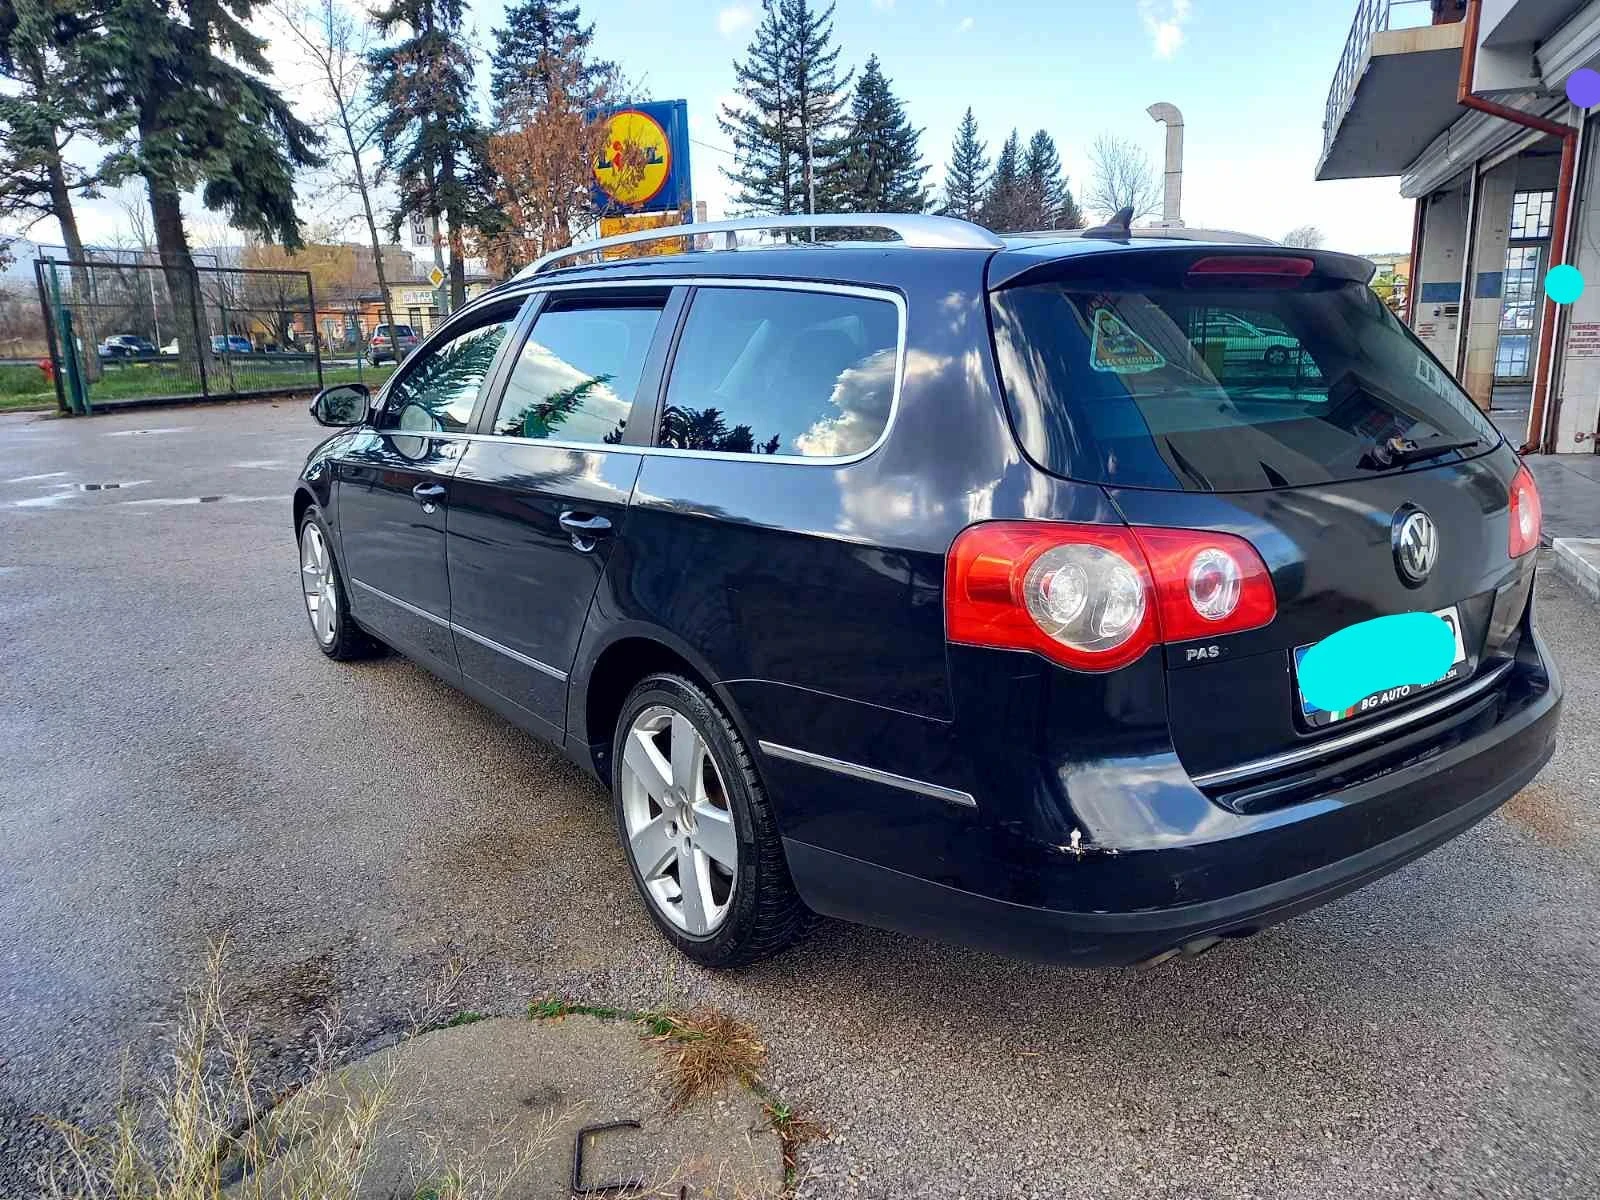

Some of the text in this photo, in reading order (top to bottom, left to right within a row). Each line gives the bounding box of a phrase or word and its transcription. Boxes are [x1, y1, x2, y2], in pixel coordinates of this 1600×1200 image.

[1186, 645, 1220, 661] PAS
[1361, 696, 1378, 710] BG
[1380, 685, 1410, 705] AUTO
